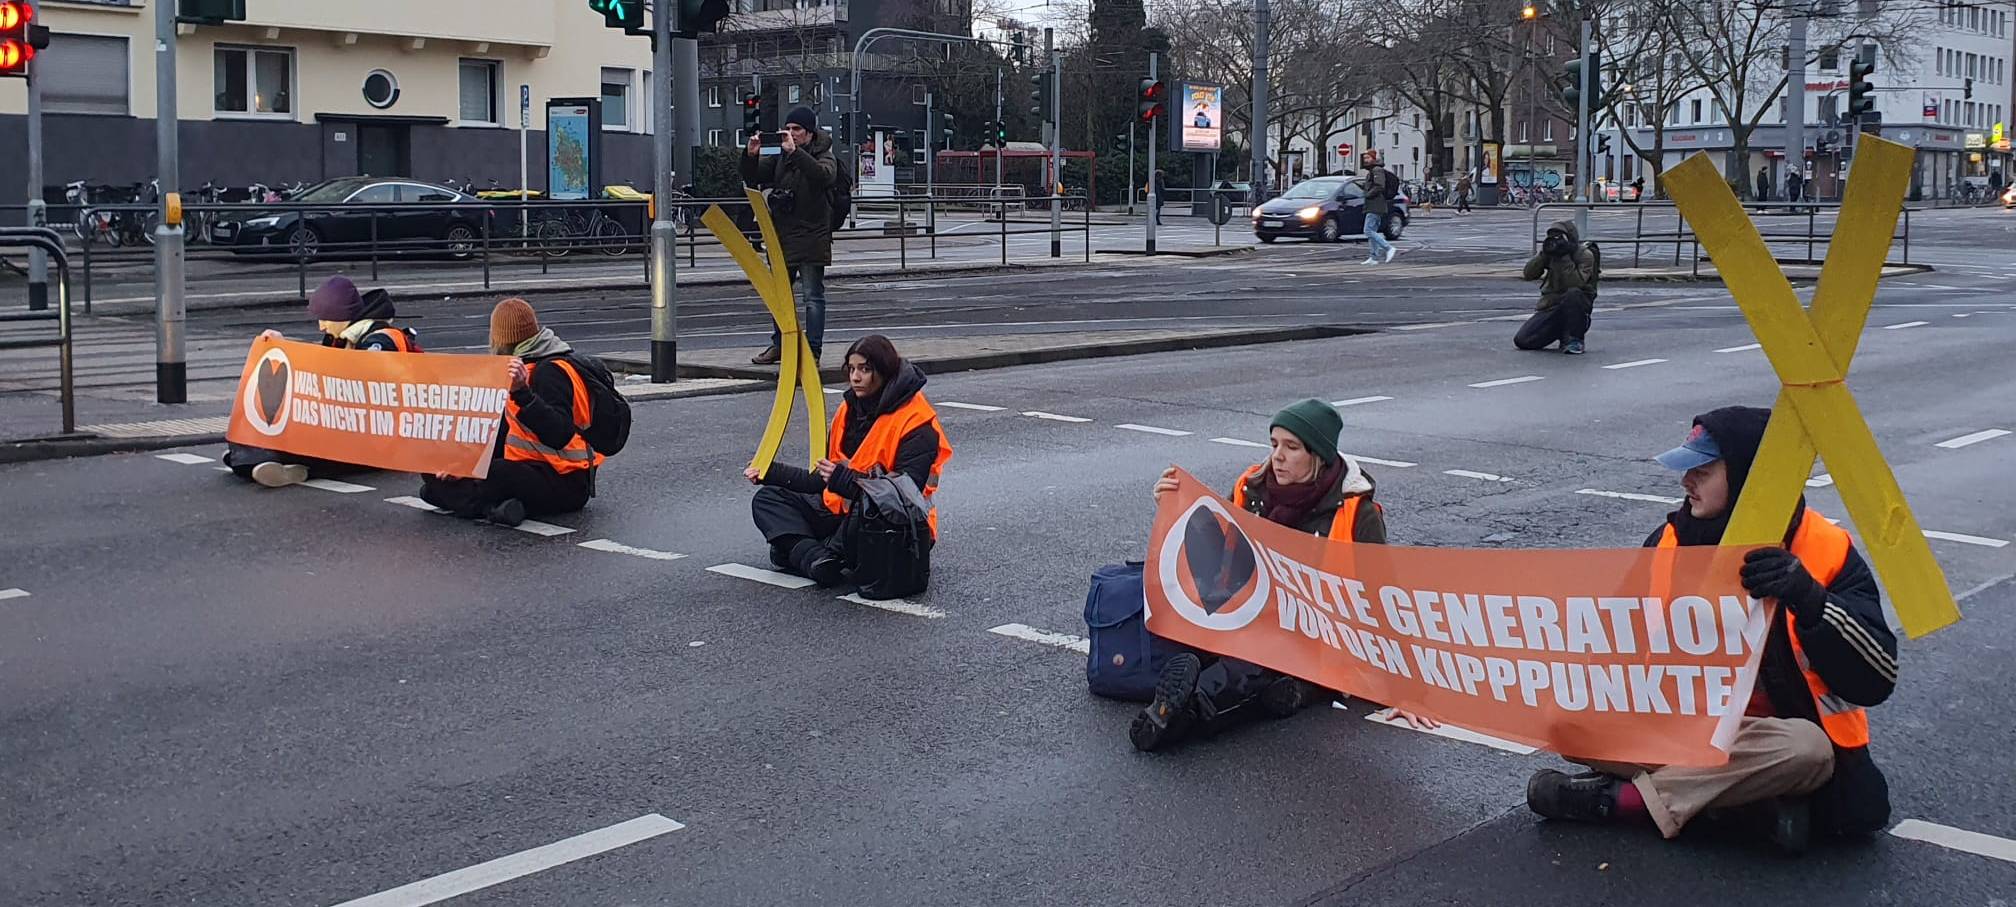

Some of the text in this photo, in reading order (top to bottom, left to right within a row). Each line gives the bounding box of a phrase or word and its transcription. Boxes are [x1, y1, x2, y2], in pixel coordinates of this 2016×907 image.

[292, 398, 319, 426] DAS
[320, 403, 366, 433] NICHT
[370, 409, 394, 436] IM
[399, 412, 454, 442] GRIFF
[294, 370, 508, 414] WAS, WENN DIE REGIERUNG
[1255, 538, 1766, 655] LETZTE GENERATION
[1275, 586, 1341, 650] VOR
[1334, 620, 1412, 679] DEN
